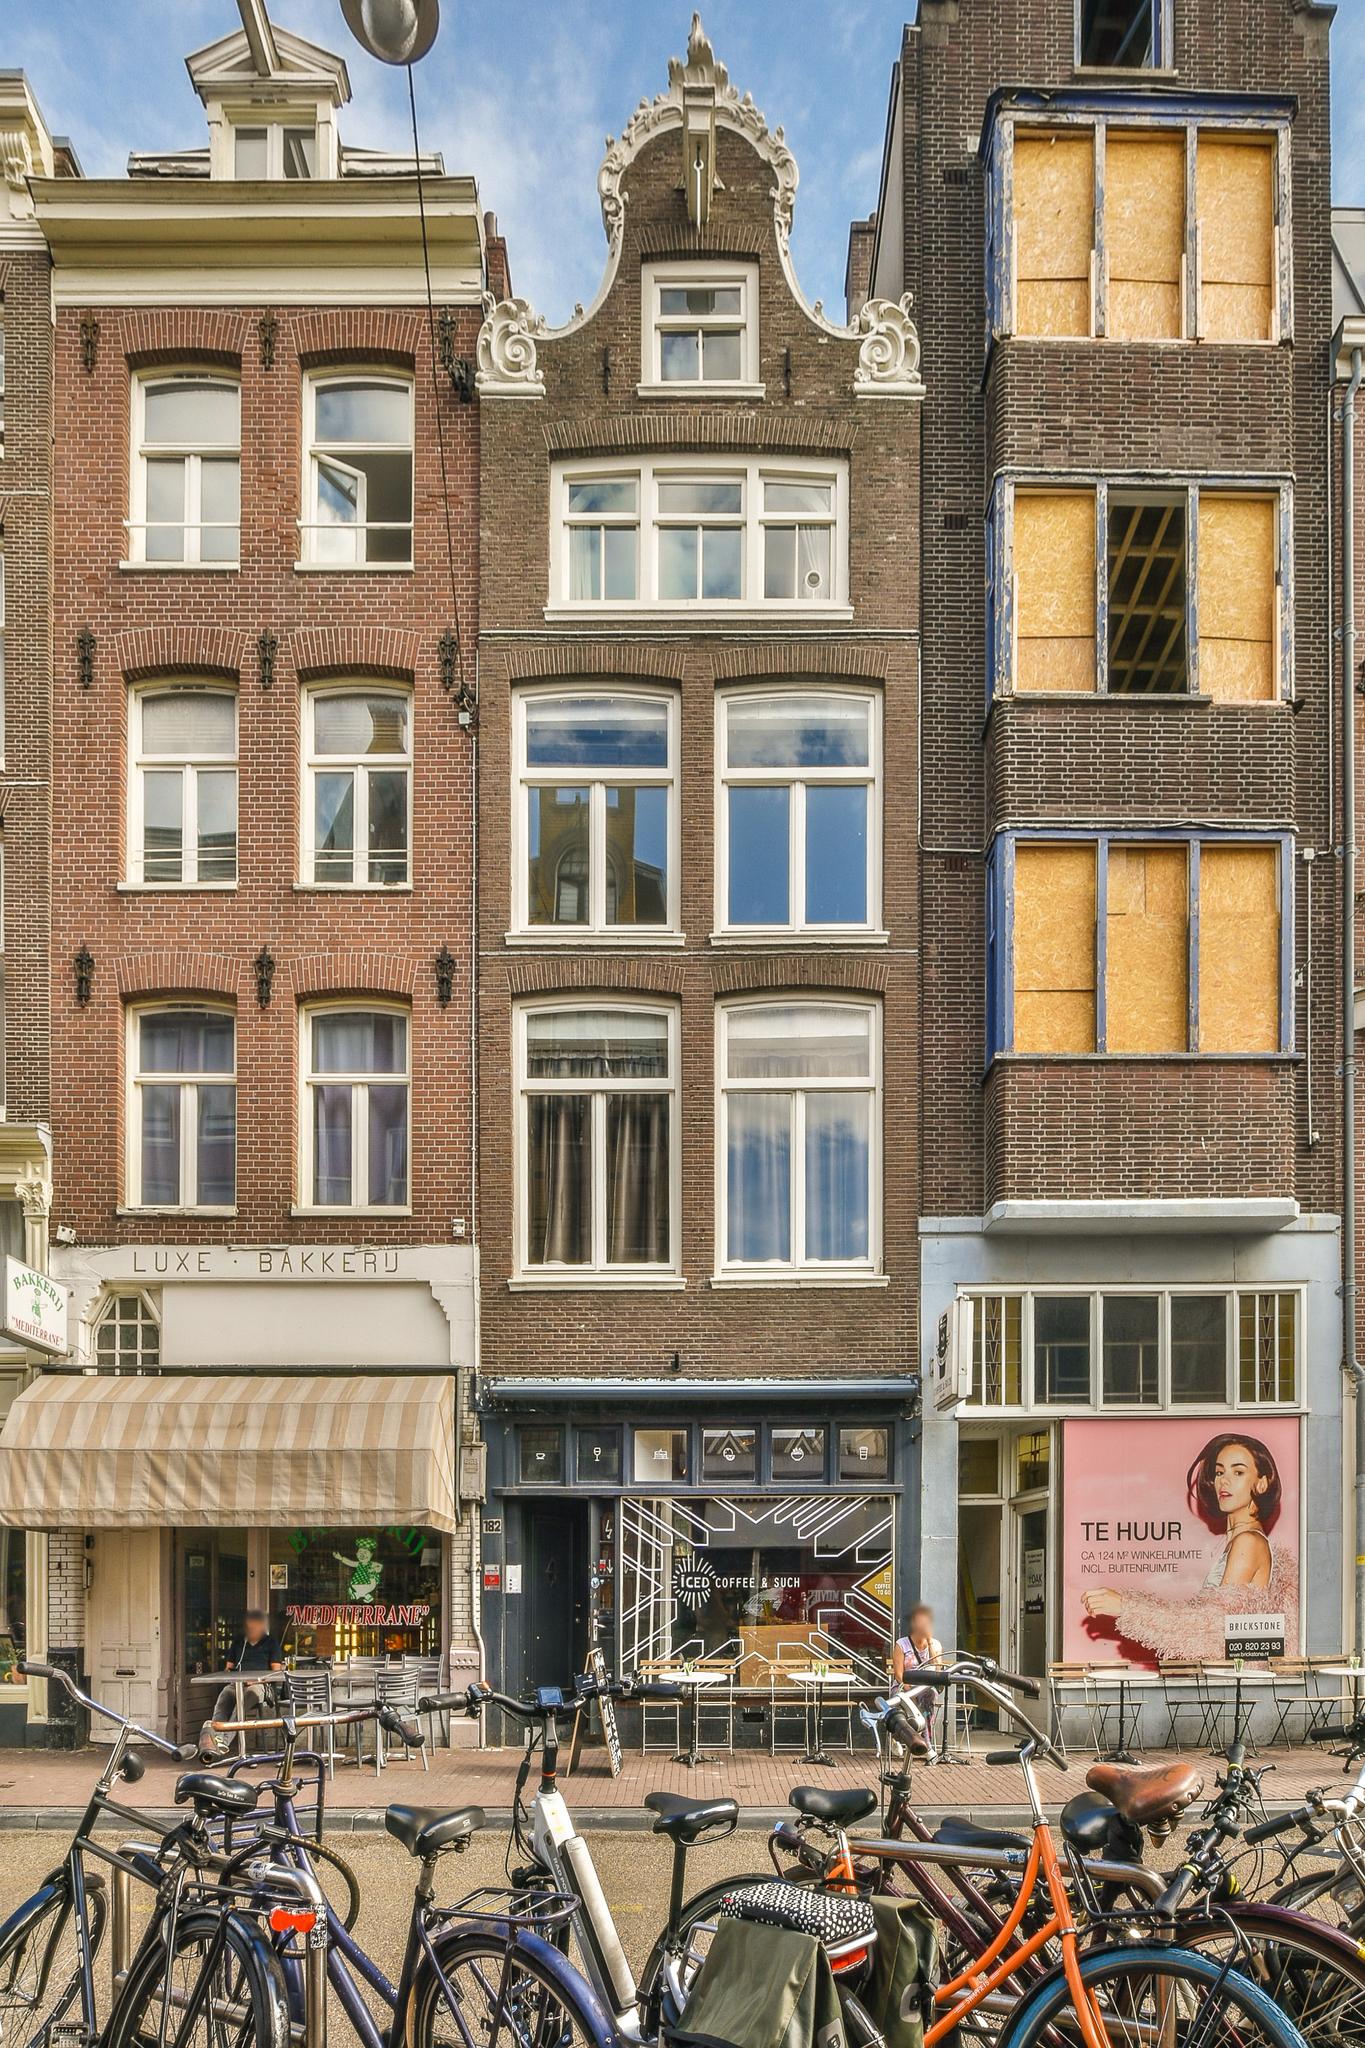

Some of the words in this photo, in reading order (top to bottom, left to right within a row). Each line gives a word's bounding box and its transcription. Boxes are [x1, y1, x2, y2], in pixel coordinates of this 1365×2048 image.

[133, 1252, 211, 1273] LUXE
[259, 1252, 398, 1273] BAKKERIJ
[13, 1272, 64, 1312] BAKKERIJ
[483, 1520, 501, 1532] 182
[1080, 1522, 1109, 1541] TE
[1117, 1521, 1182, 1541] HUUR
[1081, 1551, 1095, 1560] CA
[1099, 1551, 1114, 1560] 124
[1131, 1550, 1202, 1560] WINKELRUIMTE
[1081, 1564, 1106, 1574] INCL.
[1108, 1563, 1179, 1573] BUITENRUIMTE
[715, 1577, 756, 1588] COFFEE
[761, 1577, 768, 1588] &
[774, 1577, 800, 1588] SUCH
[1229, 1621, 1281, 1631] BRICKSTONE
[1228, 1643, 1243, 1651] 020
[1245, 1642, 1259, 1650] 820
[1260, 1642, 1270, 1650] 23
[1271, 1642, 1281, 1650] 93
